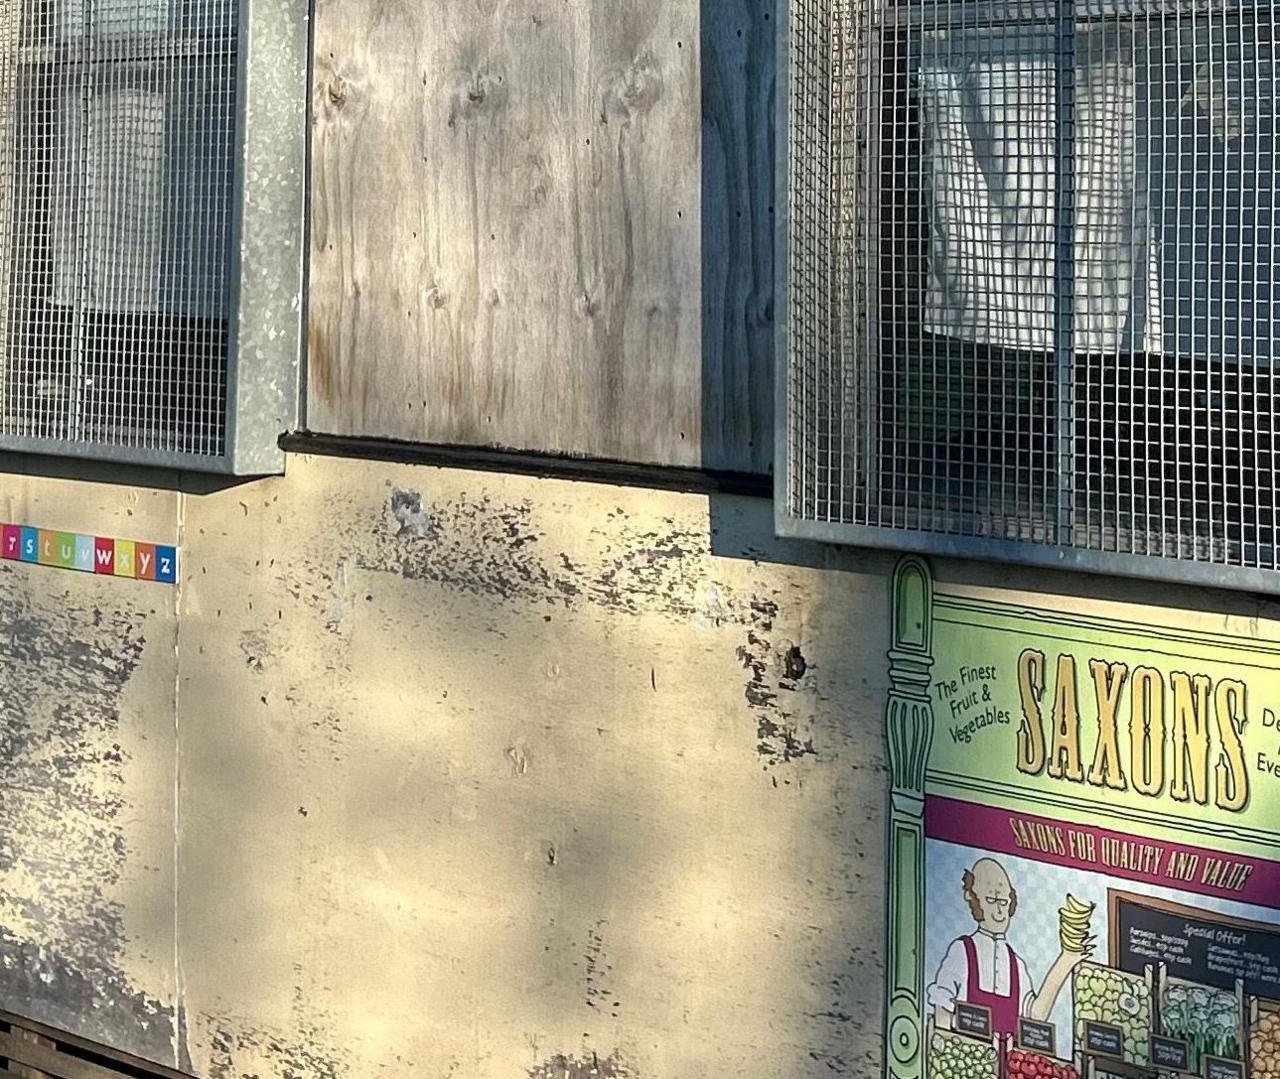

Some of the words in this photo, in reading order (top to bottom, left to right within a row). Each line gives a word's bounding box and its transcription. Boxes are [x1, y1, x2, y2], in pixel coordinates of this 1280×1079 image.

[935, 679, 958, 701] The
[959, 665, 997, 685] Finest
[950, 690, 979, 719] Fruit
[982, 683, 992, 702] &
[948, 706, 1010, 744] Vegetables
[1016, 648, 1249, 812] SAXONS
[1009, 817, 1067, 857] SAXONS
[1068, 830, 1097, 863] FOR
[1101, 836, 1164, 876] QUALITY
[1165, 850, 1198, 882] AND
[1200, 858, 1253, 892] VALUE
[1183, 922, 1215, 940] Special
[1216, 930, 1247, 945] Offer!
